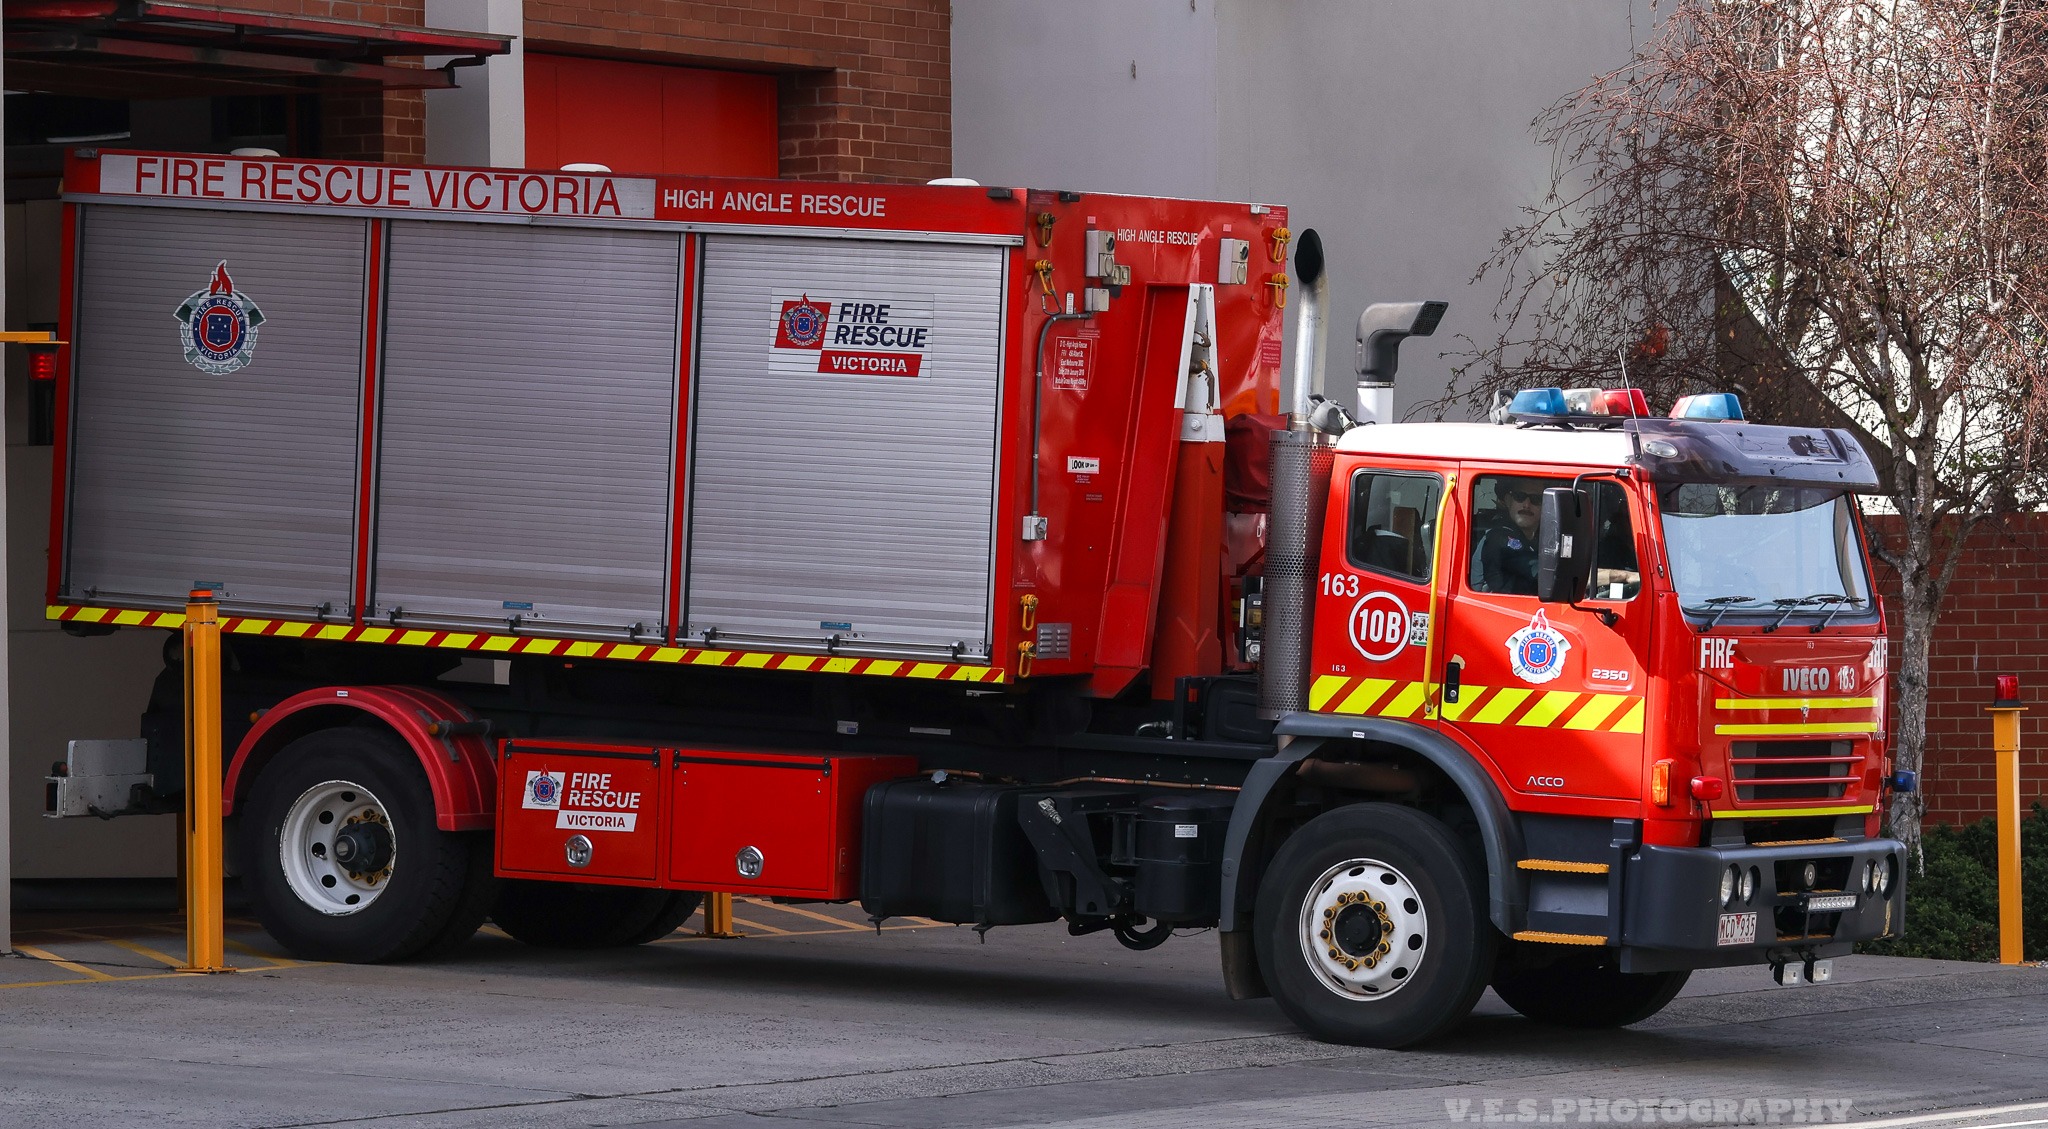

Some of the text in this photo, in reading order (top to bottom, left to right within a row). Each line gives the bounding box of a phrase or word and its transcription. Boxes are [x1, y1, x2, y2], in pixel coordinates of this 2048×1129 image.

[135, 157, 622, 216] FIRE RESCUE VICTORIA
[663, 189, 886, 217] HIGH ANGLE RESCUE
[1116, 228, 1199, 246] HIGH ANGLE RESCUE
[195, 299, 244, 322] FIRE RESCUE
[838, 302, 891, 324] FIRE
[834, 324, 928, 348] RESCUE
[200, 346, 238, 360] VICTORIA
[831, 355, 908, 373] VICTORIA
[1071, 459, 1085, 470] LOOK
[1320, 572, 1359, 598] 163
[1359, 608, 1402, 644] 10B
[1700, 637, 1739, 669] FIRE
[1331, 664, 1346, 673] 163
[1591, 668, 1629, 681] 2350
[1782, 667, 1830, 692] IVECO
[1838, 667, 1855, 691] 163
[570, 772, 612, 790] FIRE
[1526, 775, 1564, 787] ACCO
[568, 789, 641, 809] RESCUE
[566, 814, 626, 828] VICTORIA
[1719, 916, 1756, 939] MCD 935
